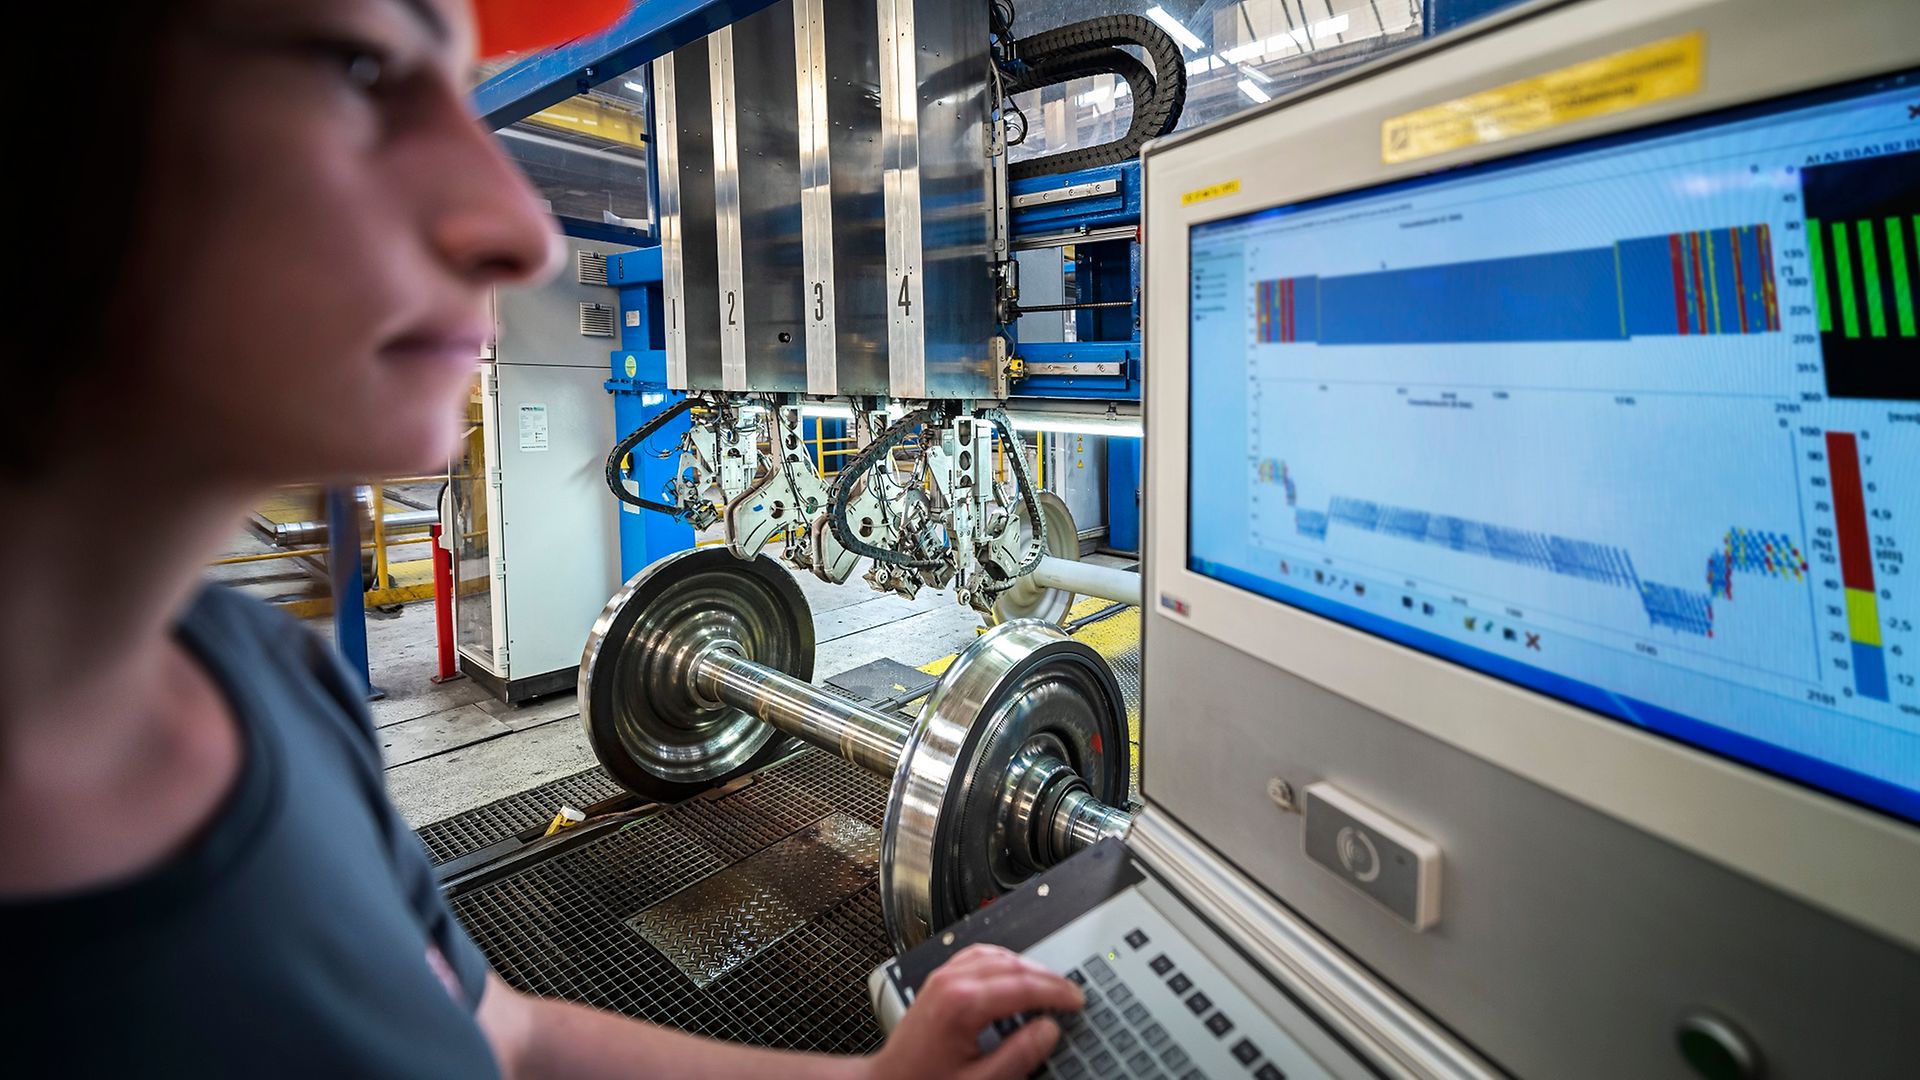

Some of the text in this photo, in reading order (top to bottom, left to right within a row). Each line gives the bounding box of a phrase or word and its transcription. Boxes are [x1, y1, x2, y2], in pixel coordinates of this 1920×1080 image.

[814, 282, 824, 321] 3
[898, 275, 911, 316] 4
[728, 291, 736, 325] 2
[1789, 305, 1811, 315] 225
[1793, 334, 1815, 344] 270
[1796, 363, 1818, 373] 315
[1815, 502, 1830, 512] 70
[1830, 631, 1845, 643] 20
[1833, 658, 1849, 670] 10
